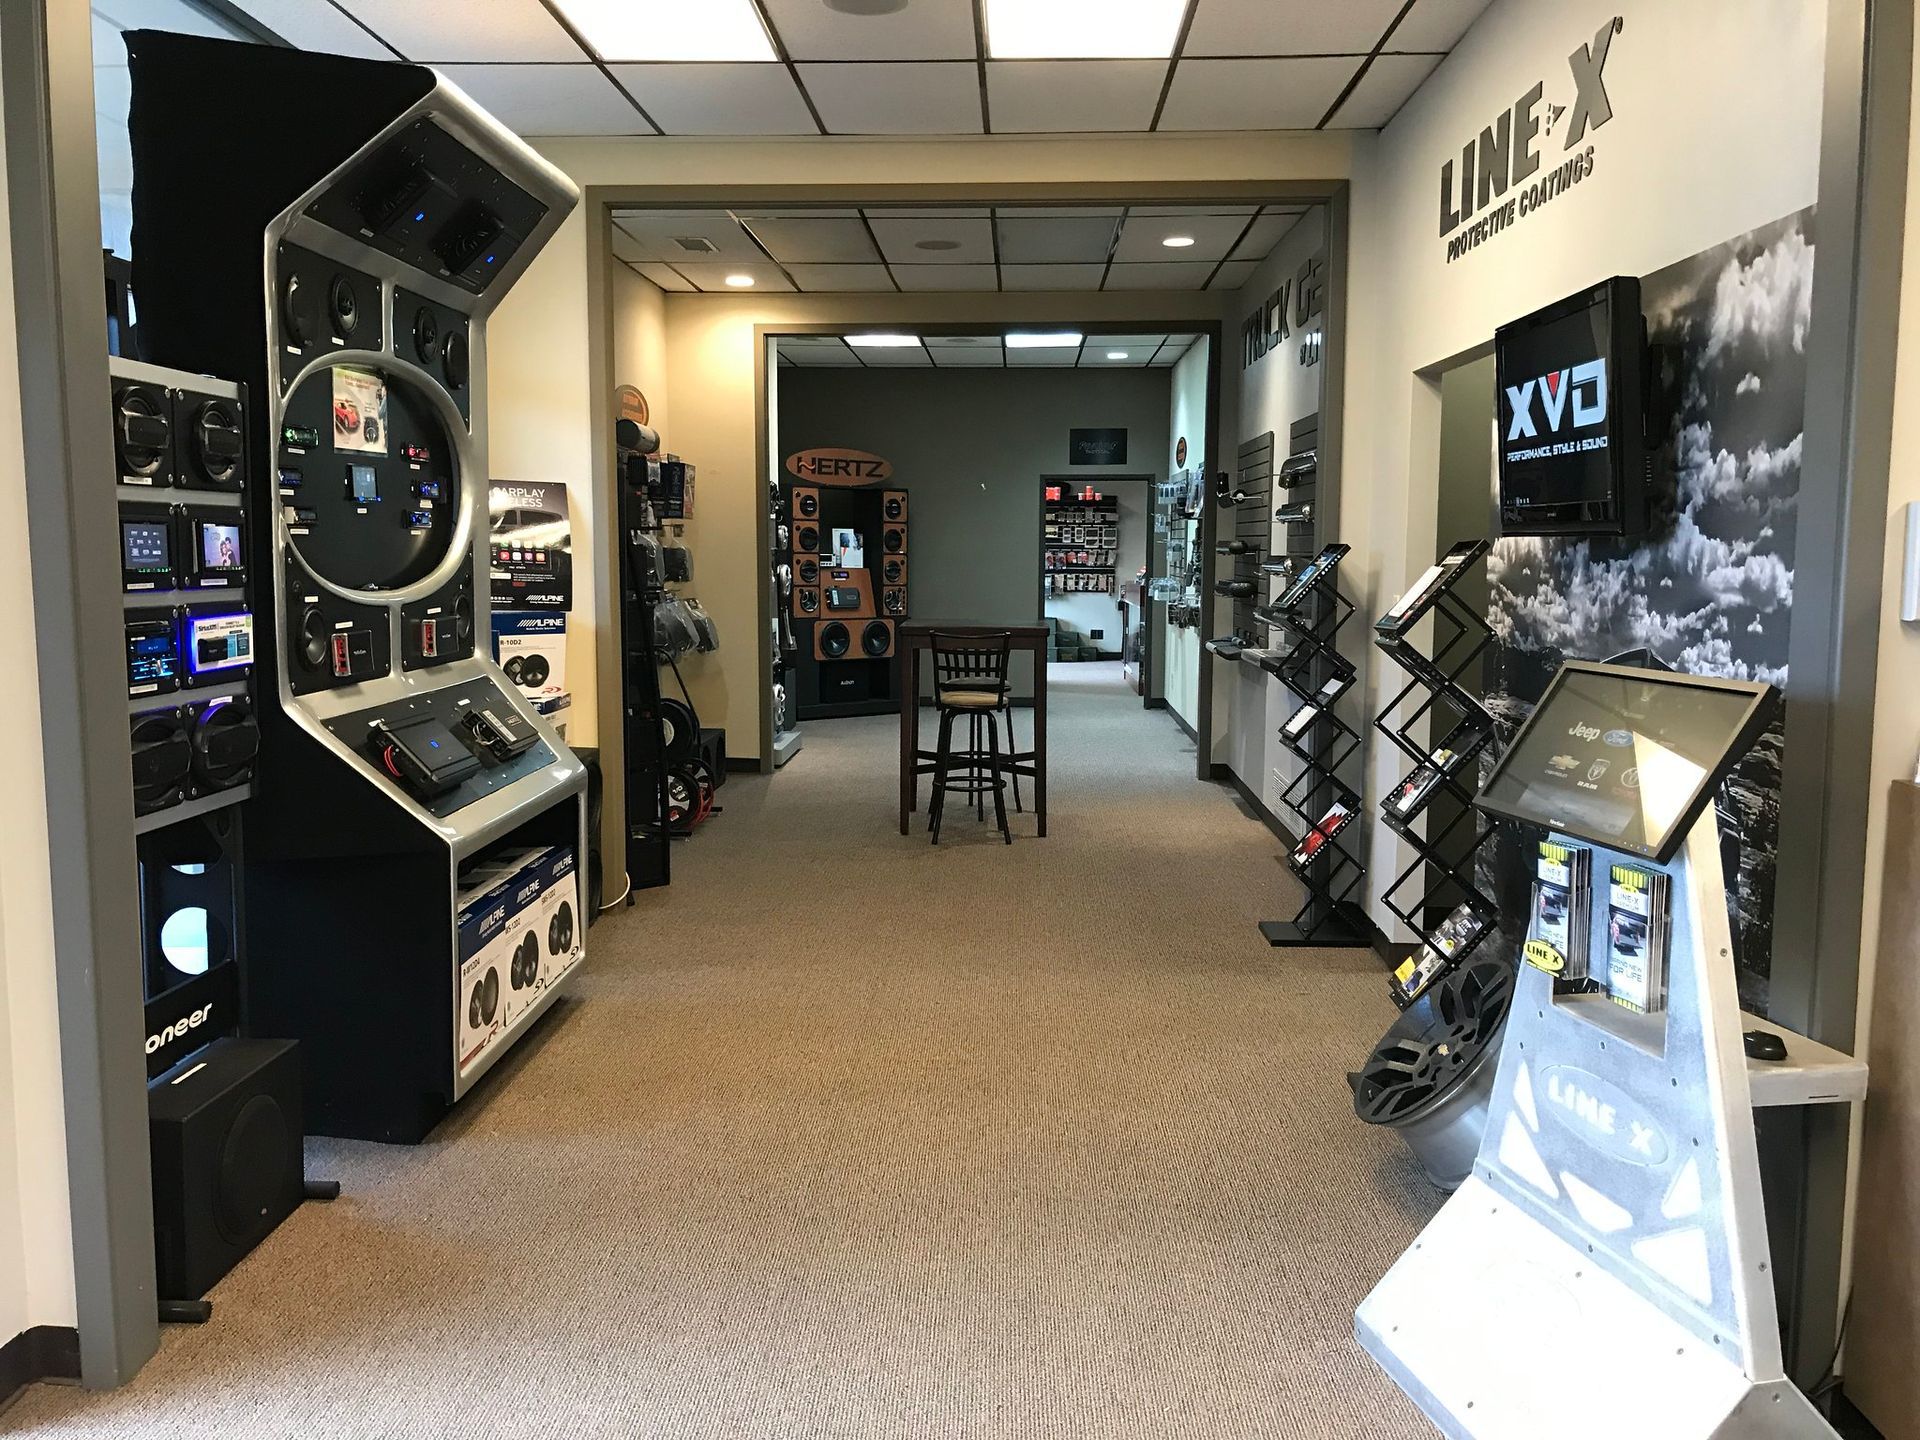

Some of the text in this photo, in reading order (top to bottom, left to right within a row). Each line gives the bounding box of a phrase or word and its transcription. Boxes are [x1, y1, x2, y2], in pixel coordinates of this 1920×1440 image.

[1446, 145, 1596, 265] PROTECTIVE COATINGS
[1240, 278, 1292, 370] TRUCK
[1505, 358, 1608, 442] XVD
[1552, 440, 1575, 456] STYLE
[1581, 435, 1608, 451] SOUND
[796, 456, 884, 478] HERTZ
[531, 594, 564, 602] ALPINE
[523, 618, 564, 628] ALPINE
[1568, 721, 1601, 742] Jeep
[553, 854, 573, 875] ALPINE
[518, 879, 541, 903] ALPINE
[482, 905, 505, 933] ALPINE
[1526, 943, 1560, 965] LINE X
[1547, 1074, 1654, 1157] LINE X
